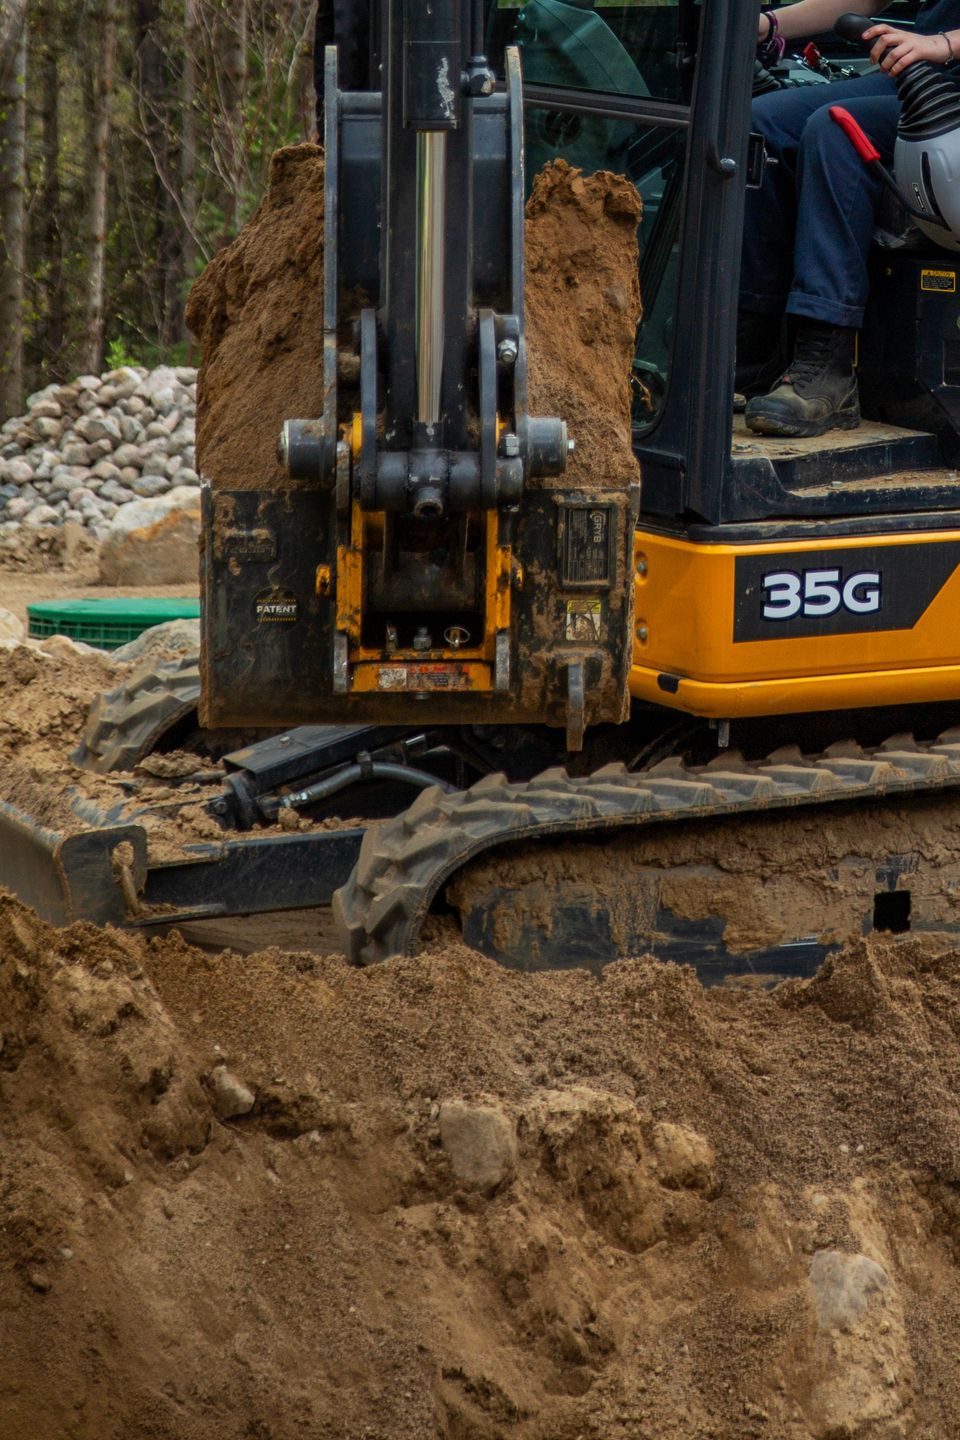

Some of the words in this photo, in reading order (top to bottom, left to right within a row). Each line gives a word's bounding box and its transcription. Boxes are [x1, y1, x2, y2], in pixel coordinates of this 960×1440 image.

[593, 515, 603, 543] GRYB
[762, 569, 880, 619] 35G
[256, 605, 297, 614] PATENT
